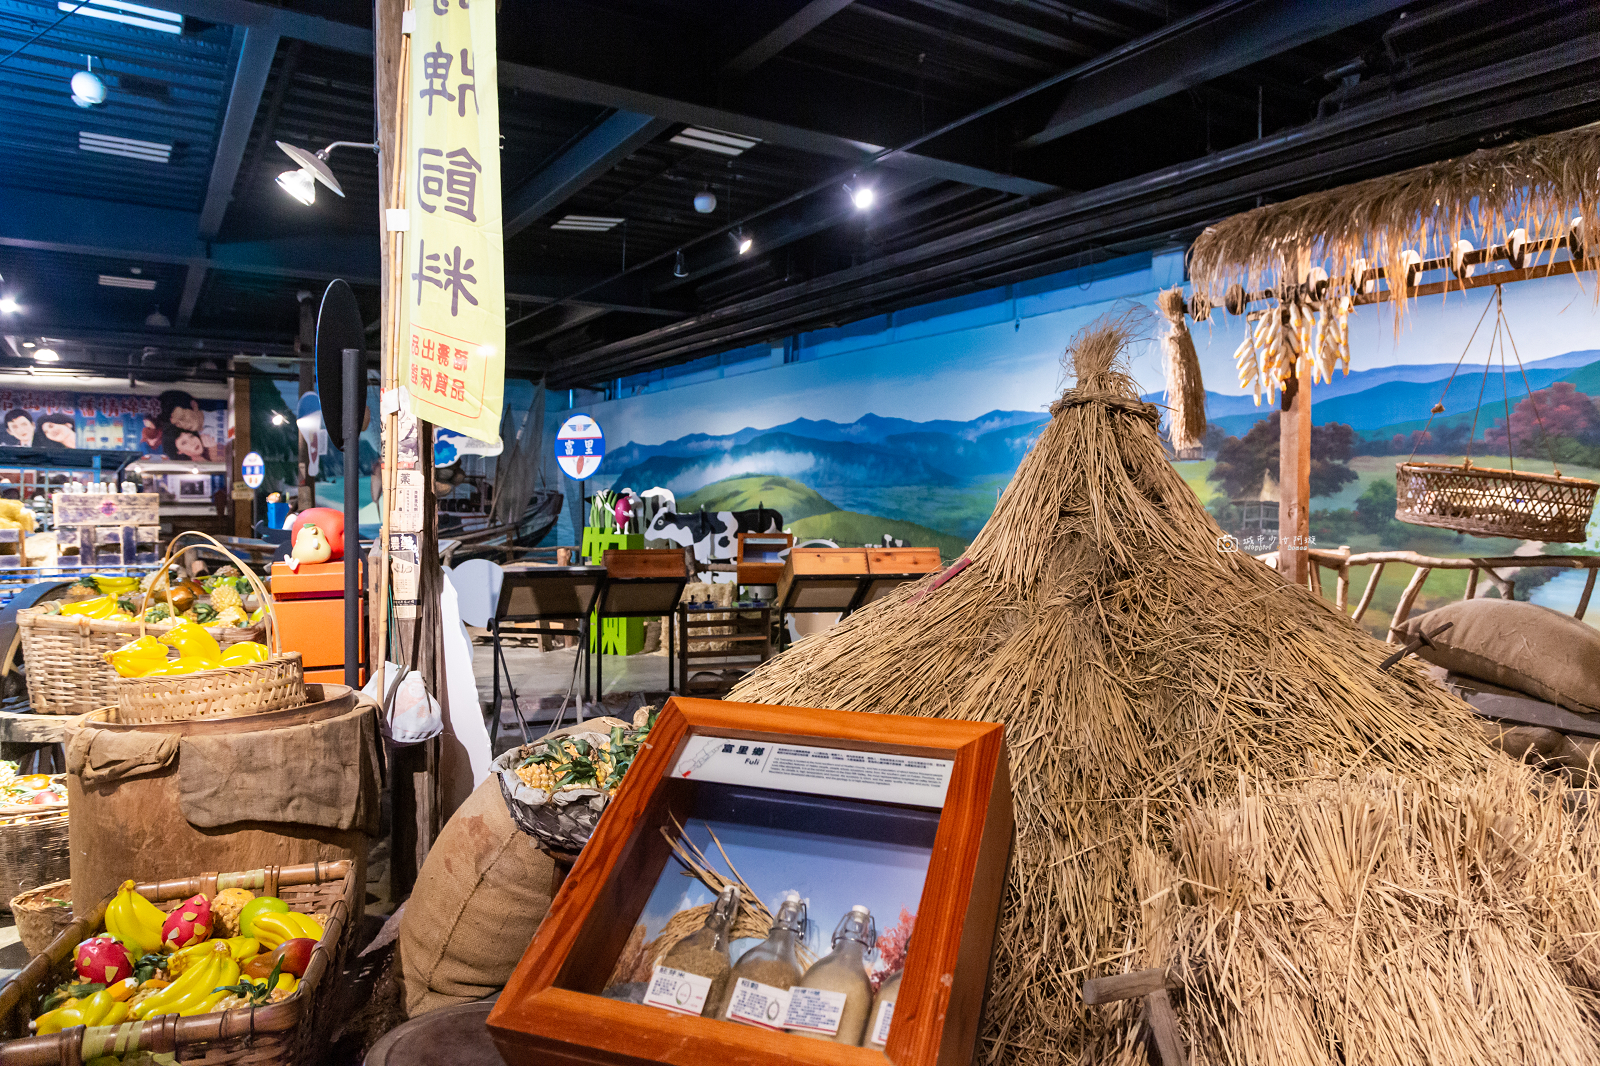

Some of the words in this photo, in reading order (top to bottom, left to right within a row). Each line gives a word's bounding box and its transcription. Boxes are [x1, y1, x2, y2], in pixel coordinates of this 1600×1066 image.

[564, 439, 594, 455] 富里
[721, 743, 765, 758] 富里鄉
[744, 757, 760, 766] Fuli
